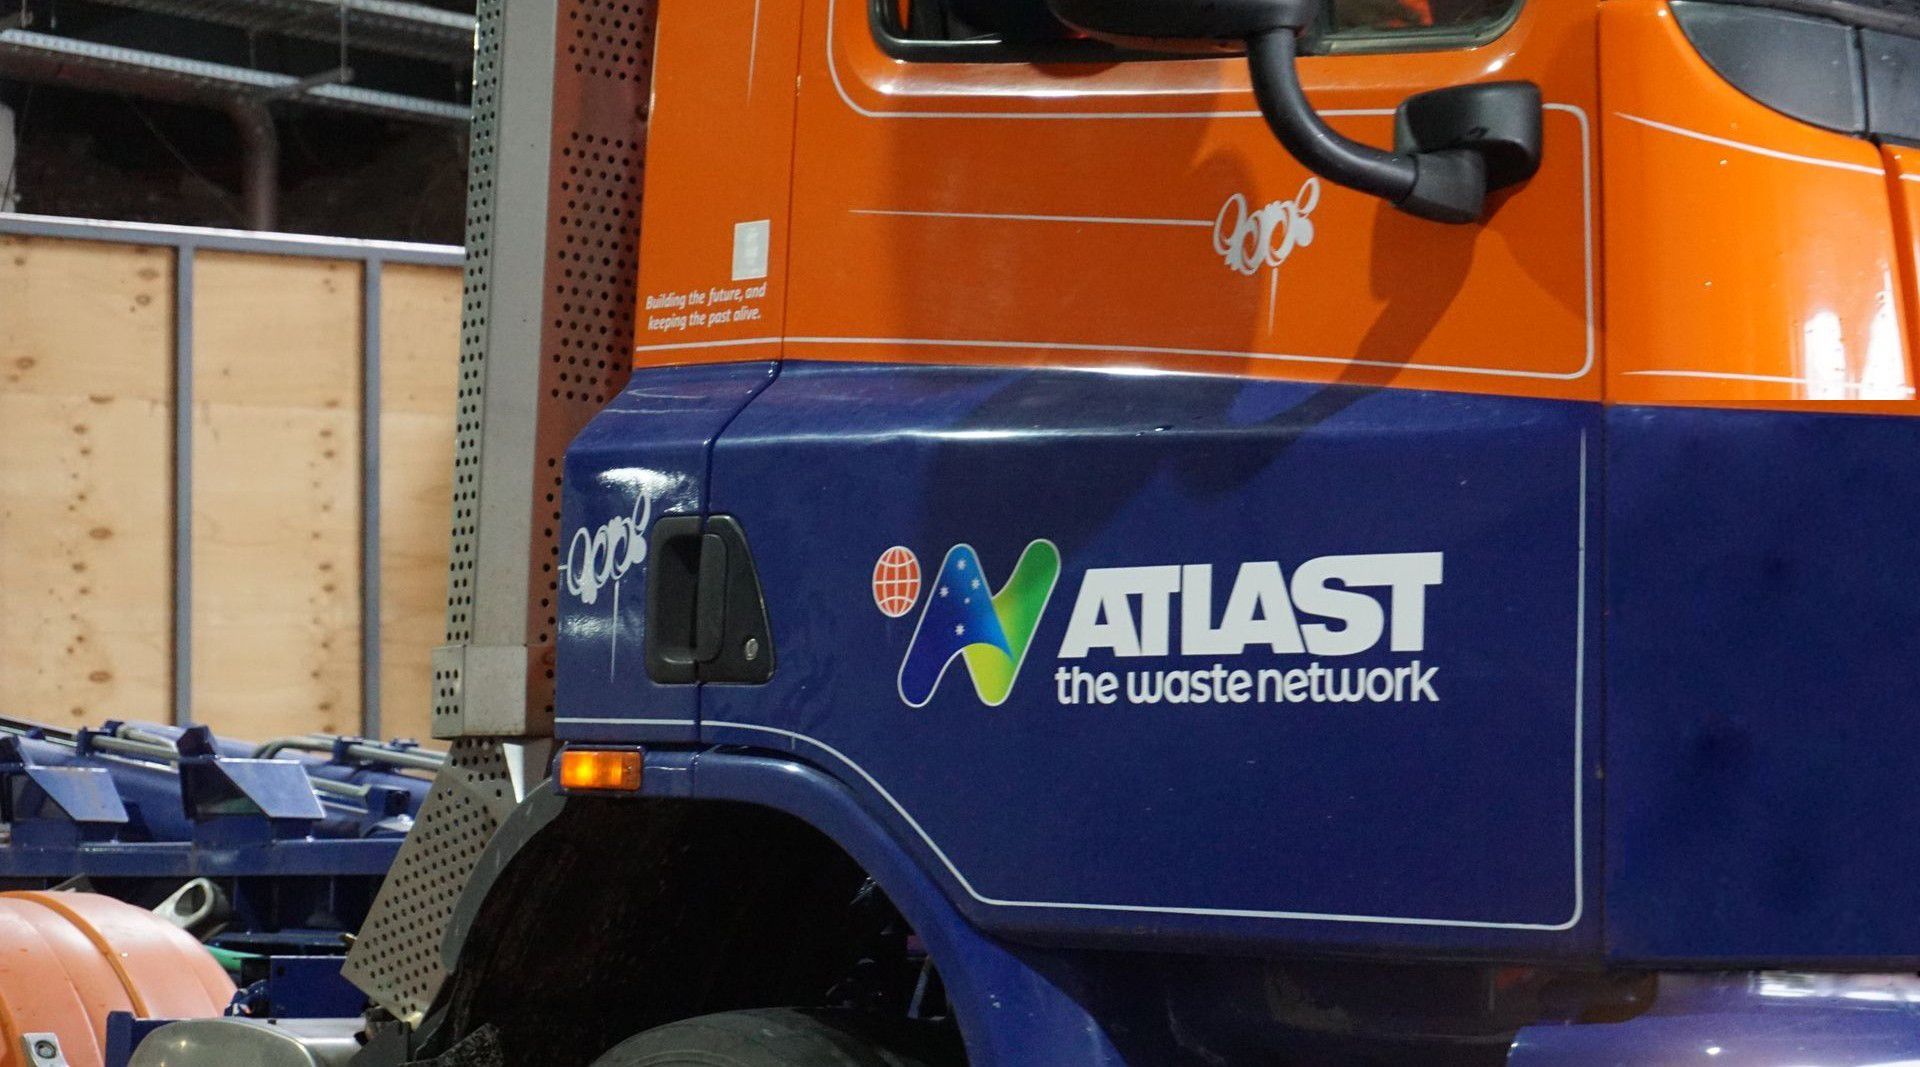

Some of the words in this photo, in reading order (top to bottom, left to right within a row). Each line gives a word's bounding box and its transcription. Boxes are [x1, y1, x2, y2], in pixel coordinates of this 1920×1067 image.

[646, 292, 686, 310] Building
[688, 290, 705, 304] the
[707, 287, 743, 306] future,
[746, 282, 768, 298] and
[649, 314, 687, 332] keeping
[689, 312, 706, 326] the
[708, 309, 731, 327] past
[733, 306, 761, 321] alive.
[1057, 551, 1443, 657] ATLAST
[1055, 666, 1118, 704] the
[1127, 662, 1252, 704] waste
[1258, 660, 1440, 702] network
